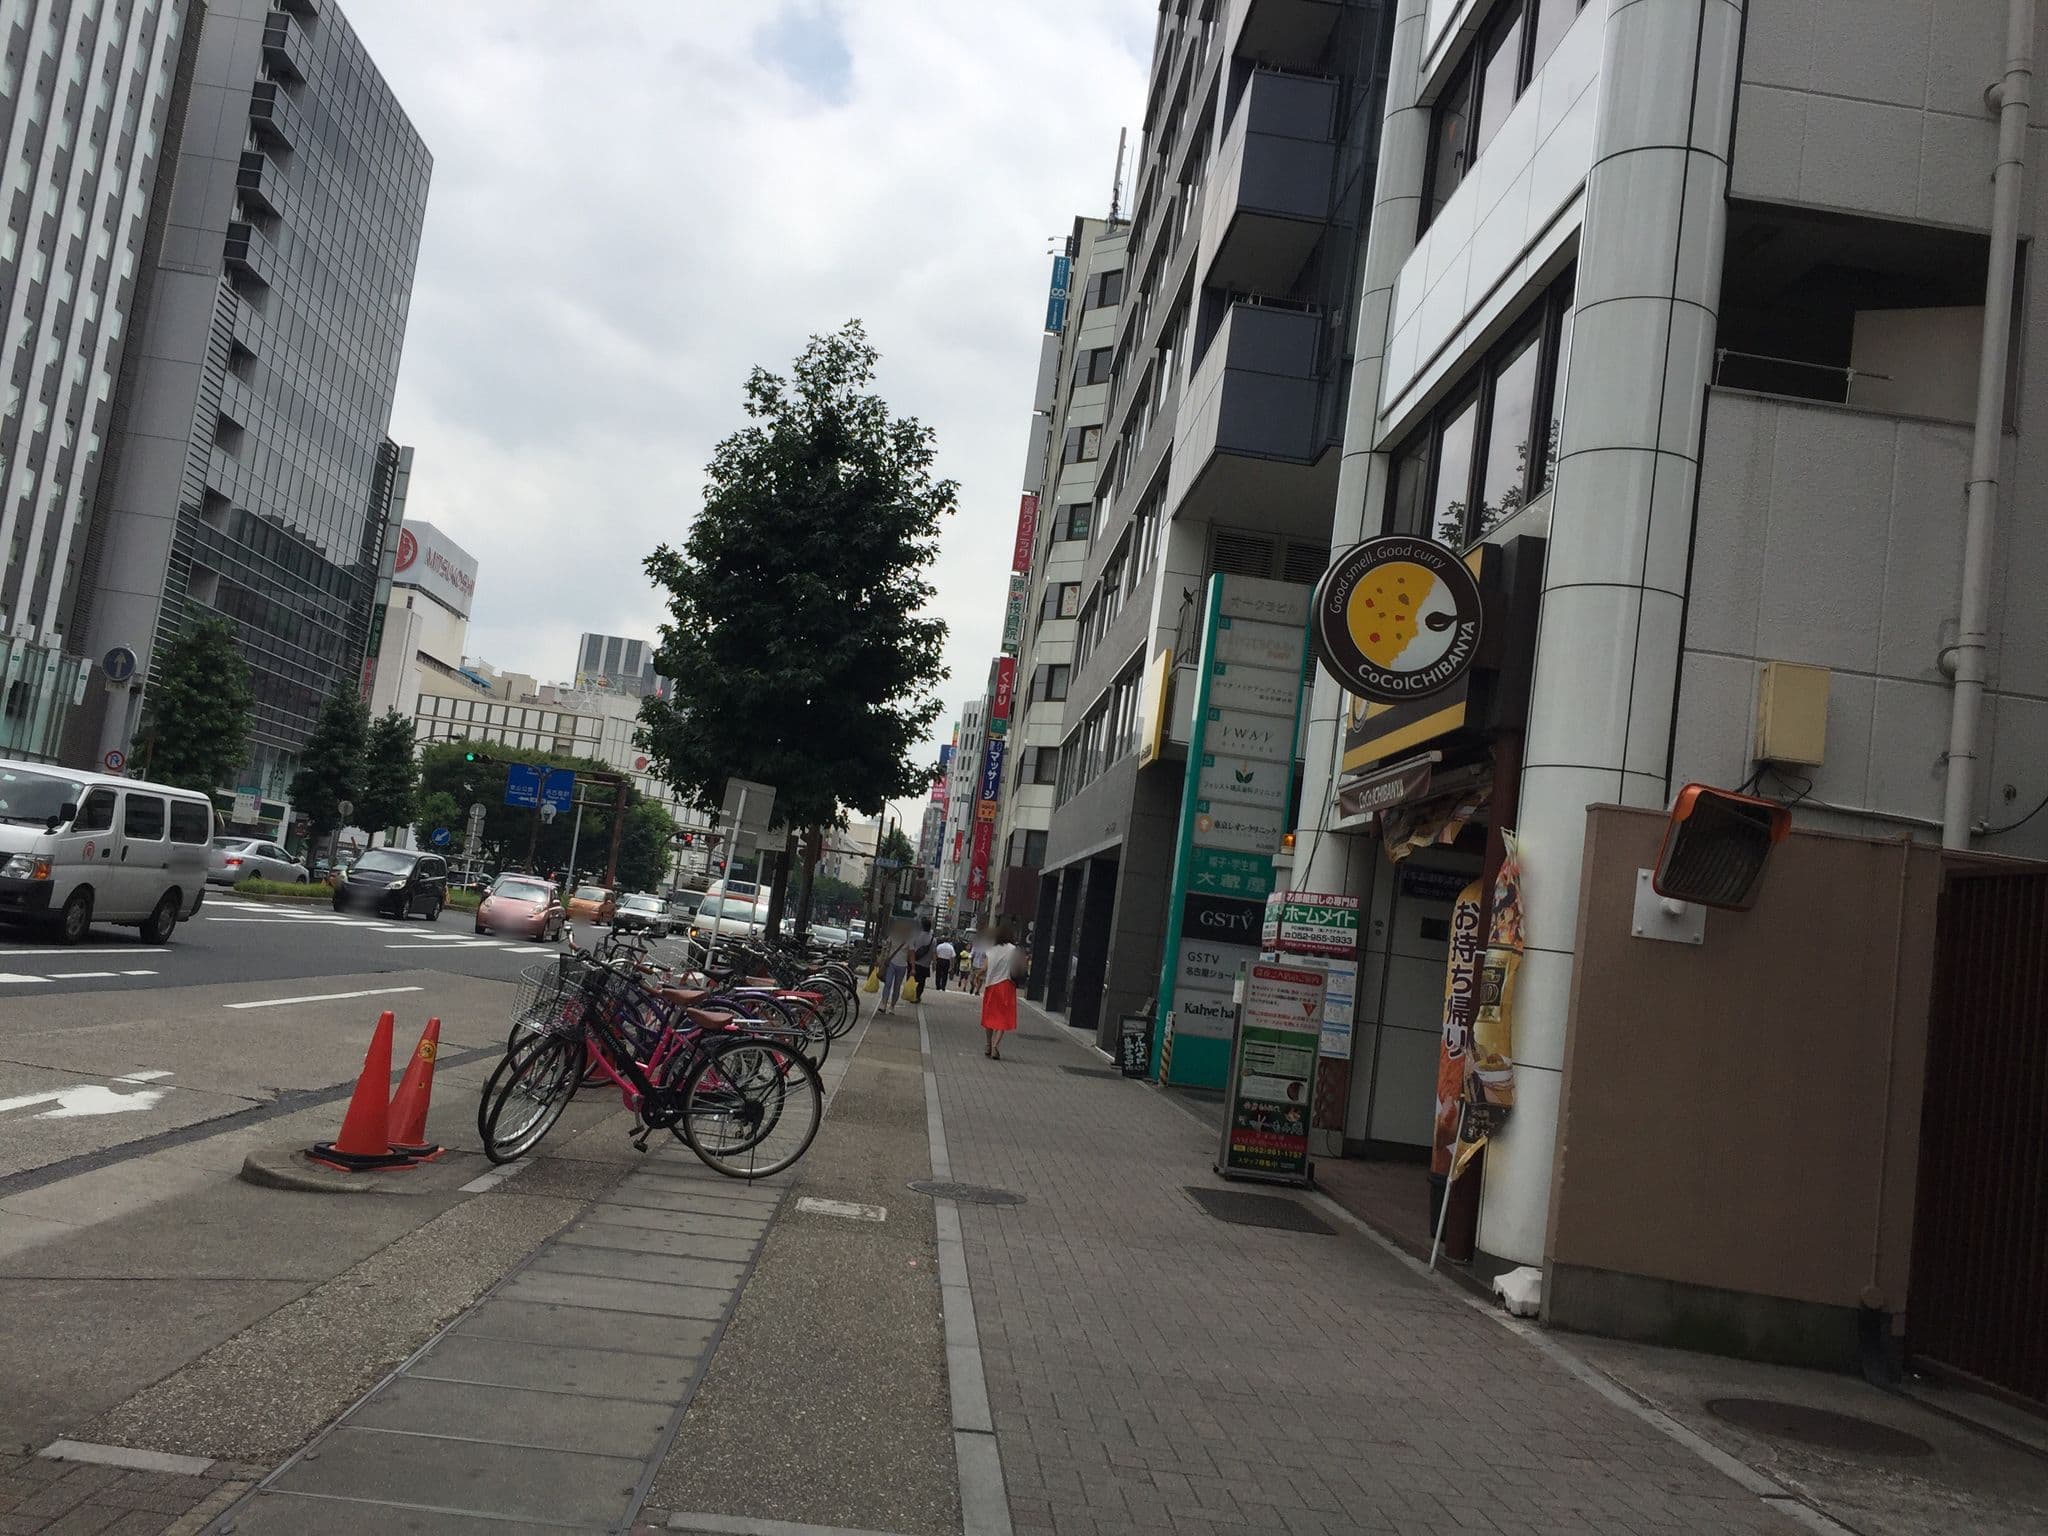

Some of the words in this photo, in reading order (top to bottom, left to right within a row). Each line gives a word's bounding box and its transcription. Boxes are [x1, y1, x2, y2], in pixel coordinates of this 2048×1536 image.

[1329, 577, 1349, 614] Good
[1347, 552, 1377, 581] smell.
[1376, 545, 1412, 559] Good
[1413, 548, 1447, 569] curry
[1358, 621, 1475, 690] CoCoICHIBANYA
[997, 671, 1011, 705] くすり
[983, 752, 999, 800] マッサージ
[1200, 908, 1254, 930] GSTV
[1284, 906, 1356, 927] ホームメイト
[1187, 951, 1220, 964] GSTV
[1446, 901, 1480, 1058] お持ち帰り
[1184, 1002, 1219, 1017] Kahve
[1220, 1004, 1235, 1019] ha
